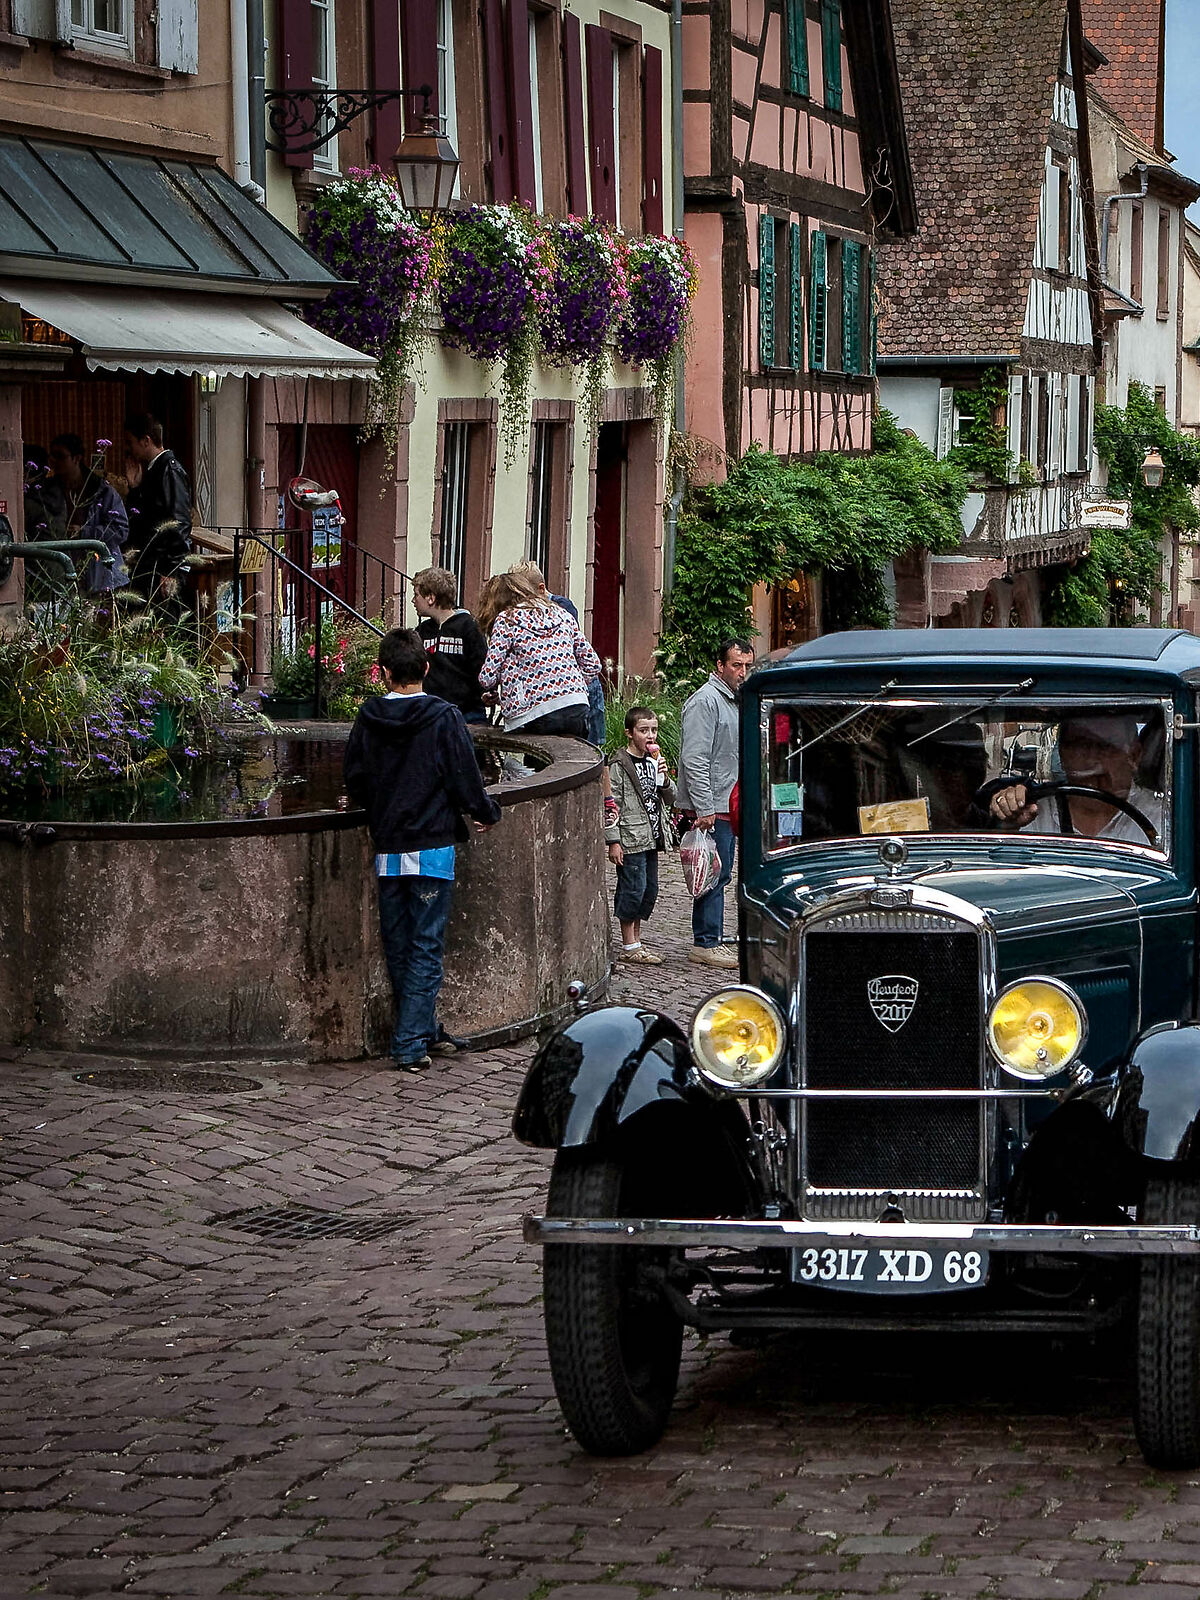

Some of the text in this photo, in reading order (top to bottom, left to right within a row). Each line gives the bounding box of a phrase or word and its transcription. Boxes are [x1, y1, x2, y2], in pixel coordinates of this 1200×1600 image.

[869, 978, 918, 1001] Peugeot
[879, 1003, 907, 1021] 201
[800, 1248, 982, 1284] 3317 XD 68
